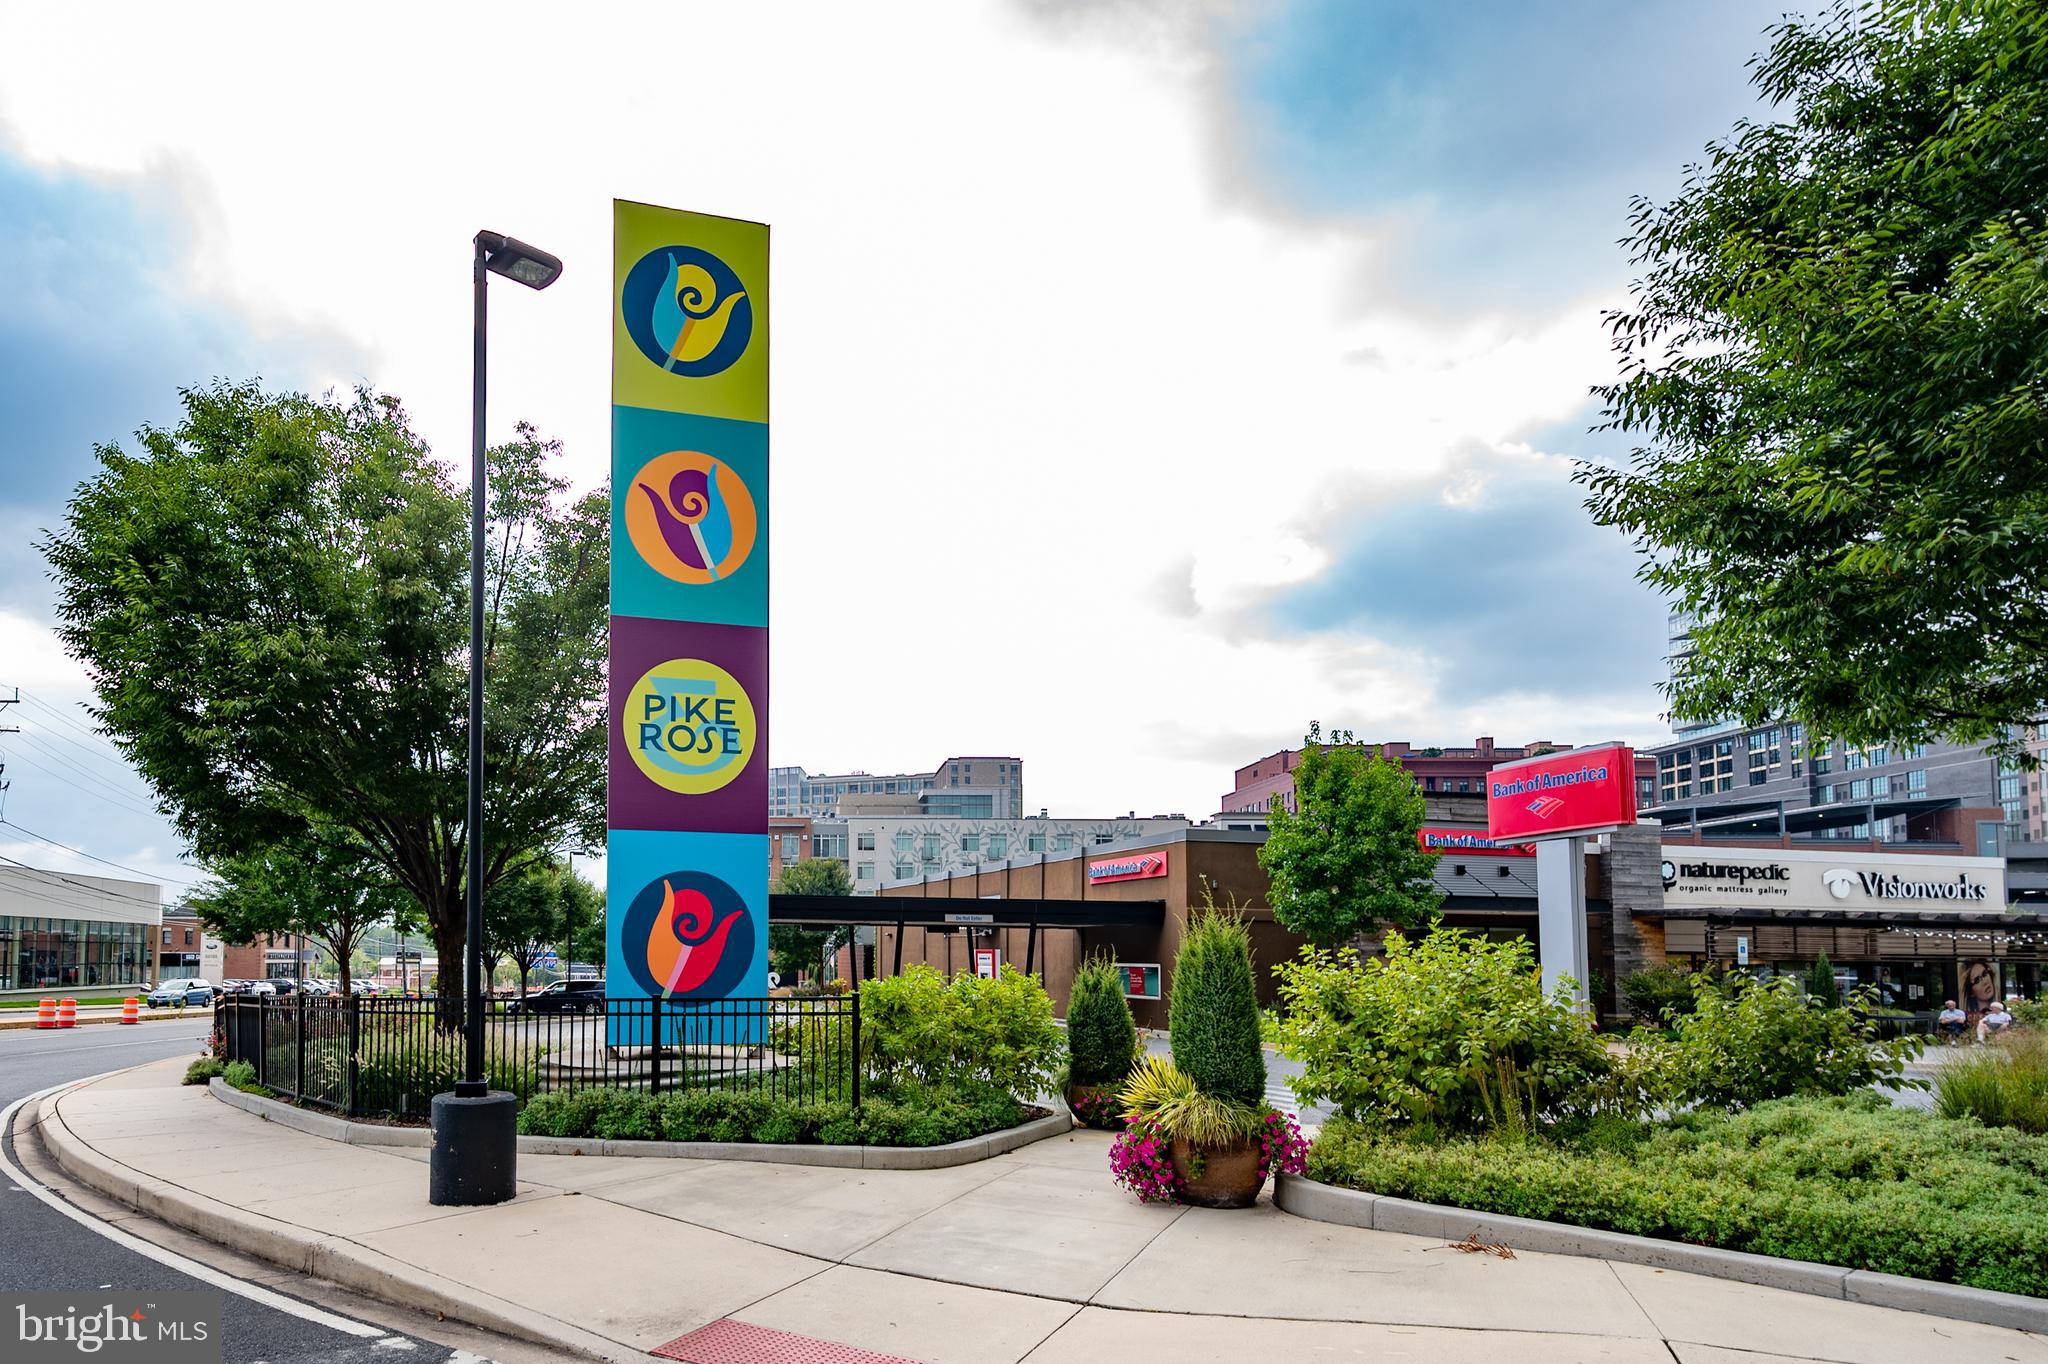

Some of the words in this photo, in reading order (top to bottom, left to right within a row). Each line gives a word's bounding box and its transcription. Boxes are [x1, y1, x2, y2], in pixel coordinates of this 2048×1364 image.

[644, 693, 736, 726] PIKE
[638, 722, 742, 755] ROSE
[1493, 779, 1525, 798] Bank
[1526, 774, 1540, 790] of
[1541, 766, 1607, 789] America
[1428, 834, 1457, 847] Bank
[1457, 834, 1468, 847] of
[1679, 861, 1790, 885] naturepedic
[1858, 871, 1988, 900] Visionworks
[1679, 884, 1712, 894] organic
[1716, 886, 1754, 894] mattress
[1757, 886, 1788, 896] gallery
